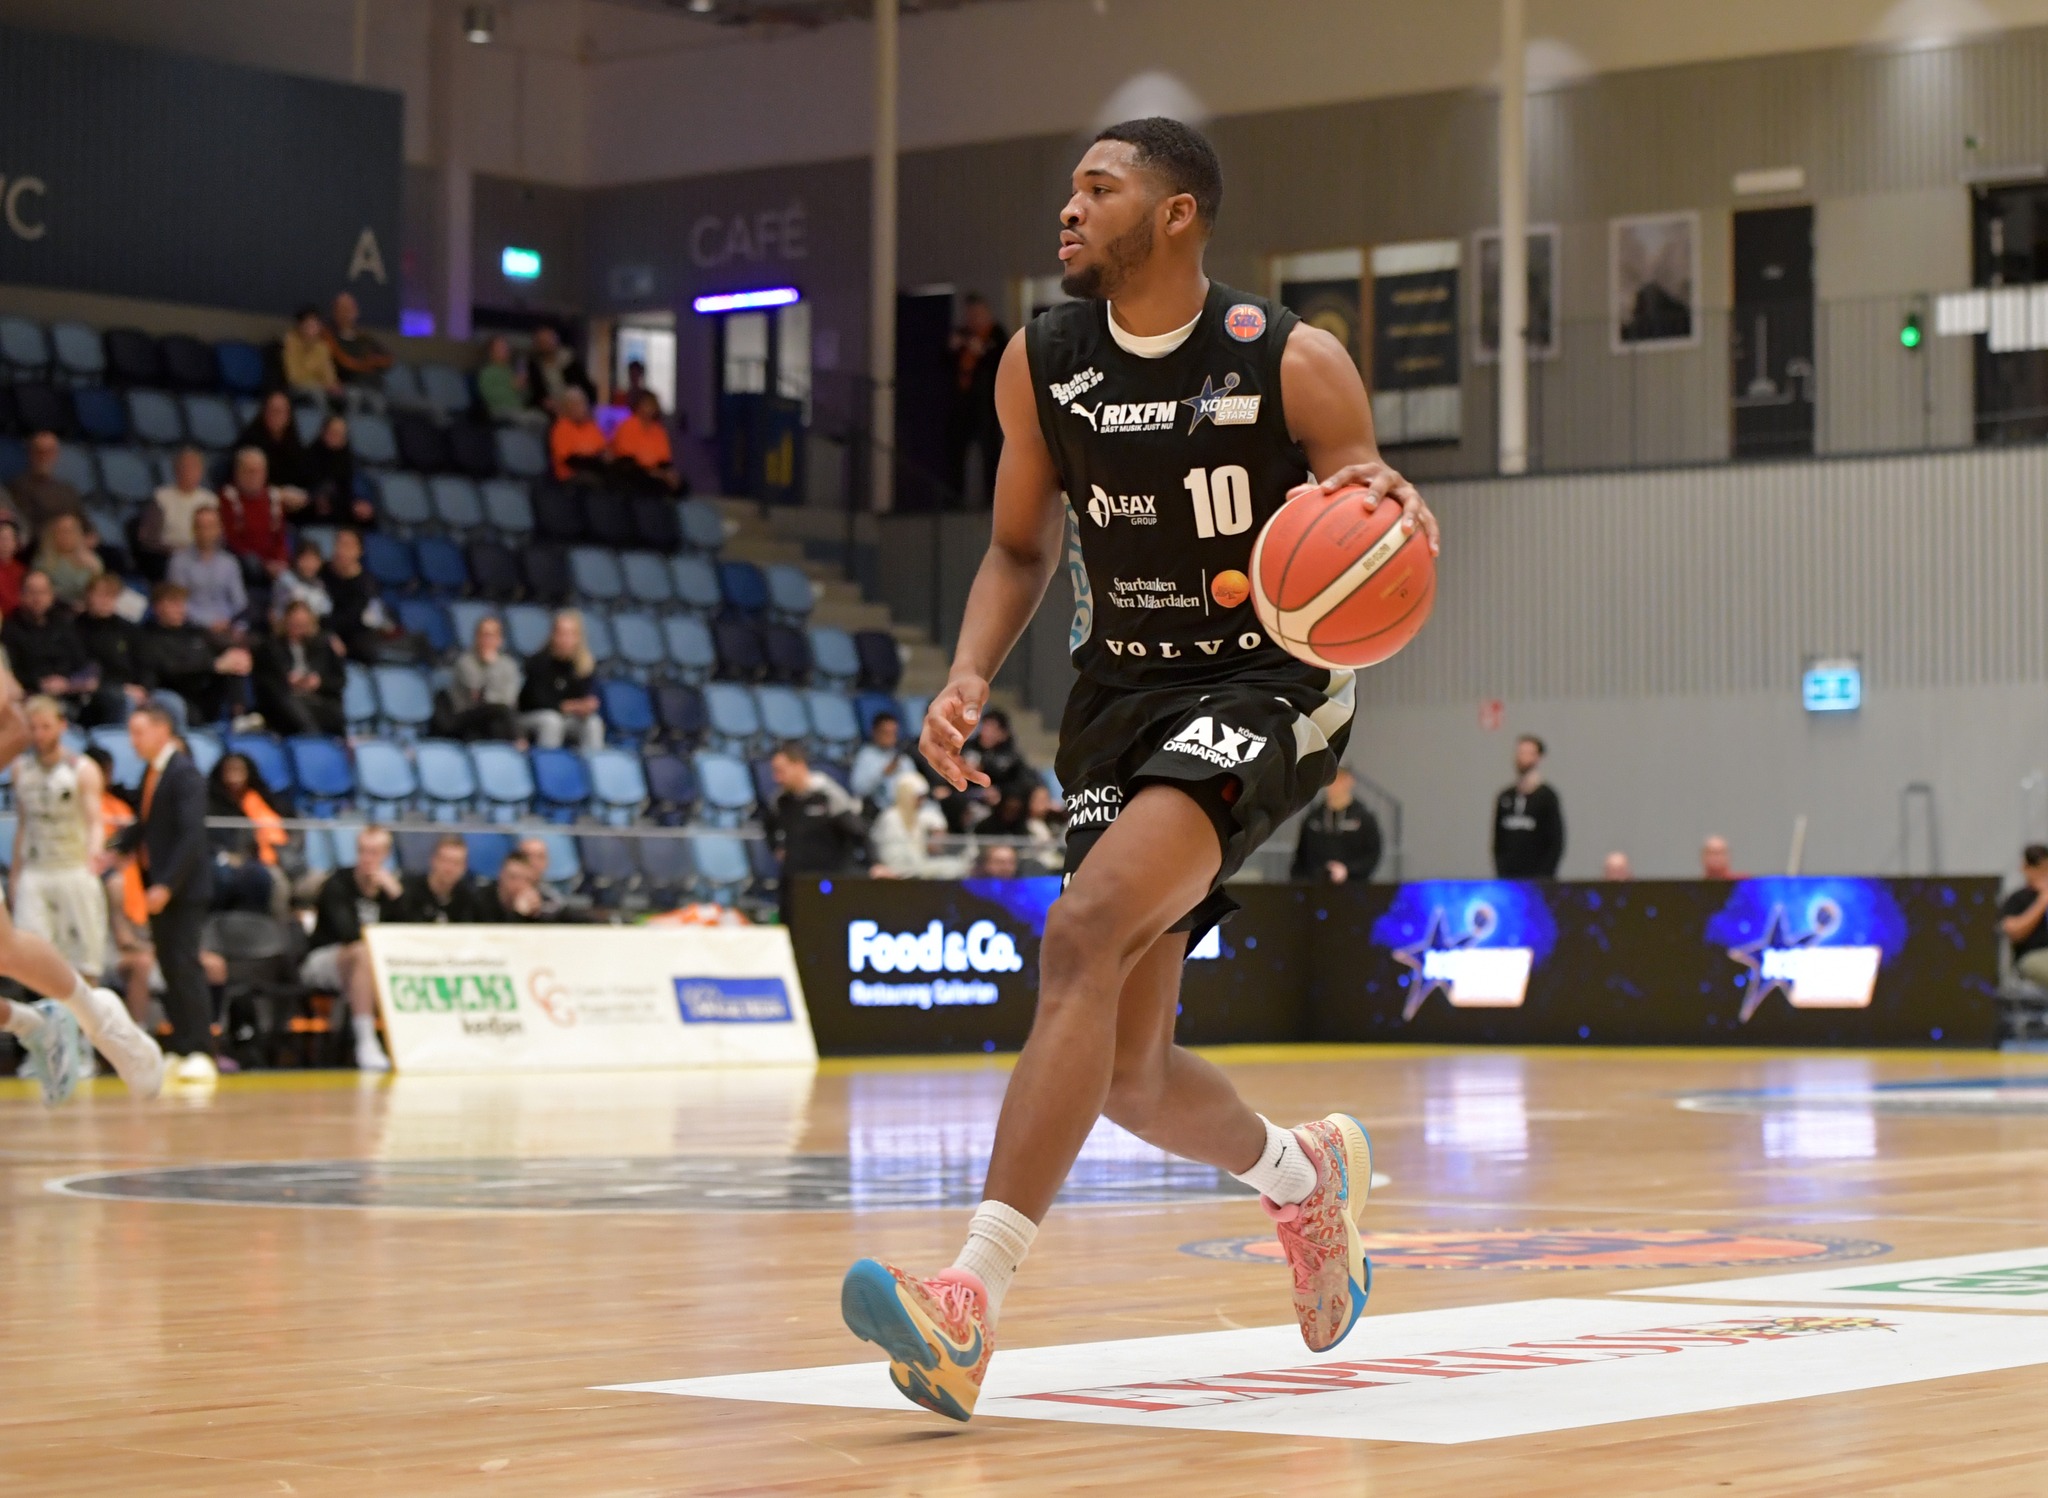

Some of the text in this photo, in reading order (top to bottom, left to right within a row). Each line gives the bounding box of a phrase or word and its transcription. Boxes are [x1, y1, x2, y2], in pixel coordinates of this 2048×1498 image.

[0, 172, 46, 240] C
[690, 204, 808, 268] CAFÉ
[350, 228, 387, 284] A
[1049, 366, 1096, 399] Basket
[1058, 372, 1104, 406] Shop.se
[1101, 401, 1178, 426] RIXFM
[1200, 397, 1259, 413] KÖPING
[1218, 411, 1255, 421] STARS
[1100, 425, 1119, 434] BÄST
[1119, 424, 1142, 433] MUSIK
[1143, 423, 1161, 431] JUST
[1108, 495, 1156, 514] LEAX
[1183, 464, 1253, 539] 10
[1131, 517, 1158, 526] GROUP
[1105, 632, 1261, 659] VOLVO
[1238, 726, 1268, 743] KÖPING
